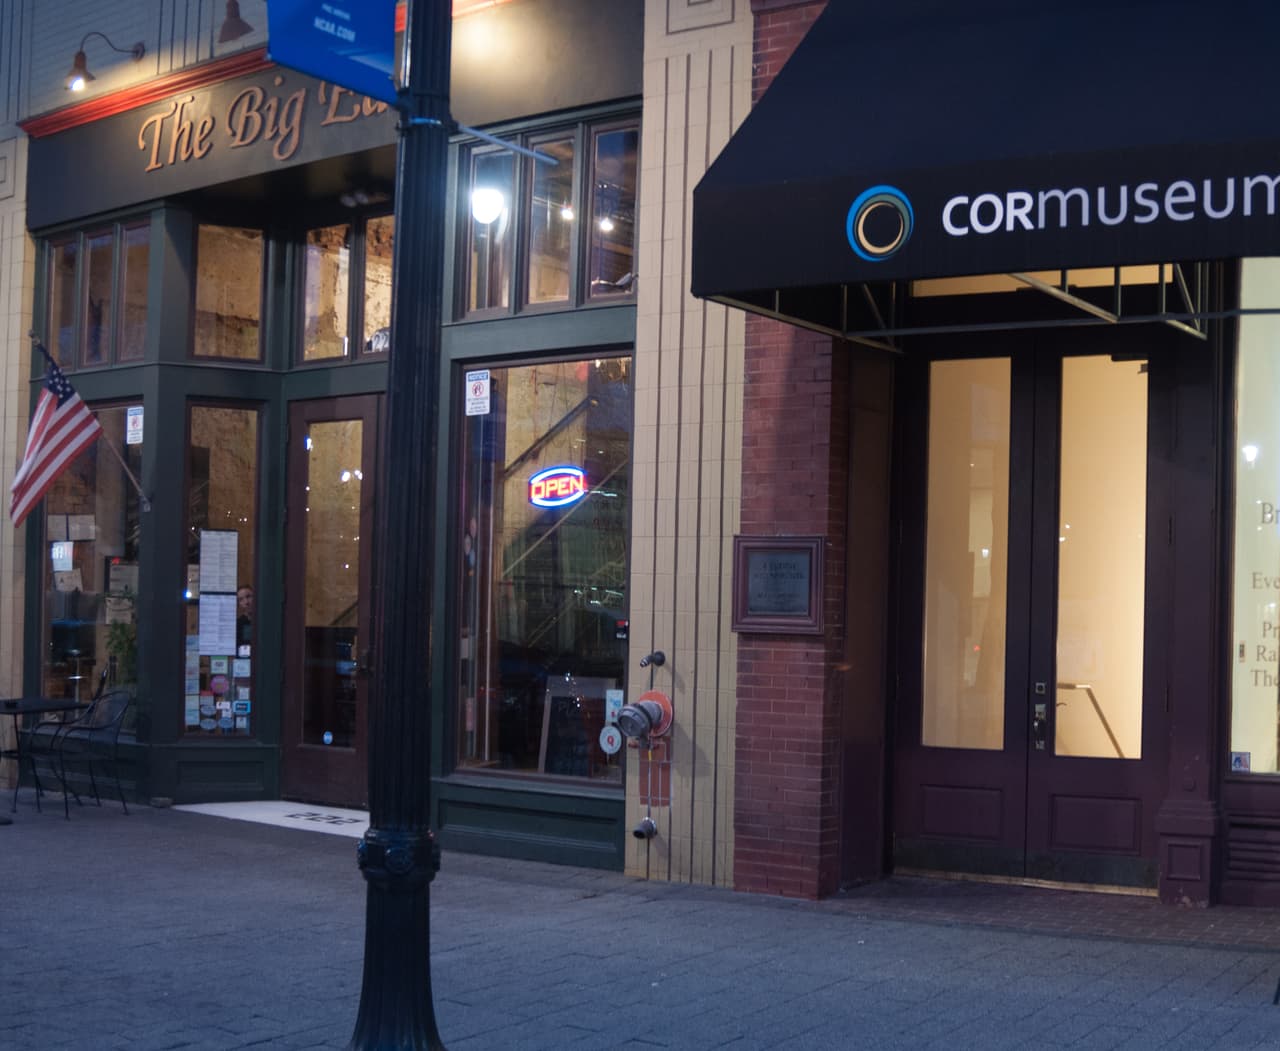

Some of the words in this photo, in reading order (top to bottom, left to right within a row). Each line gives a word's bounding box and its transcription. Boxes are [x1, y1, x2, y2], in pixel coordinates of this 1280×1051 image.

[138, 95, 215, 172] The
[226, 76, 307, 160] Big
[531, 475, 584, 499] OPEN
[283, 812, 364, 826] 222
